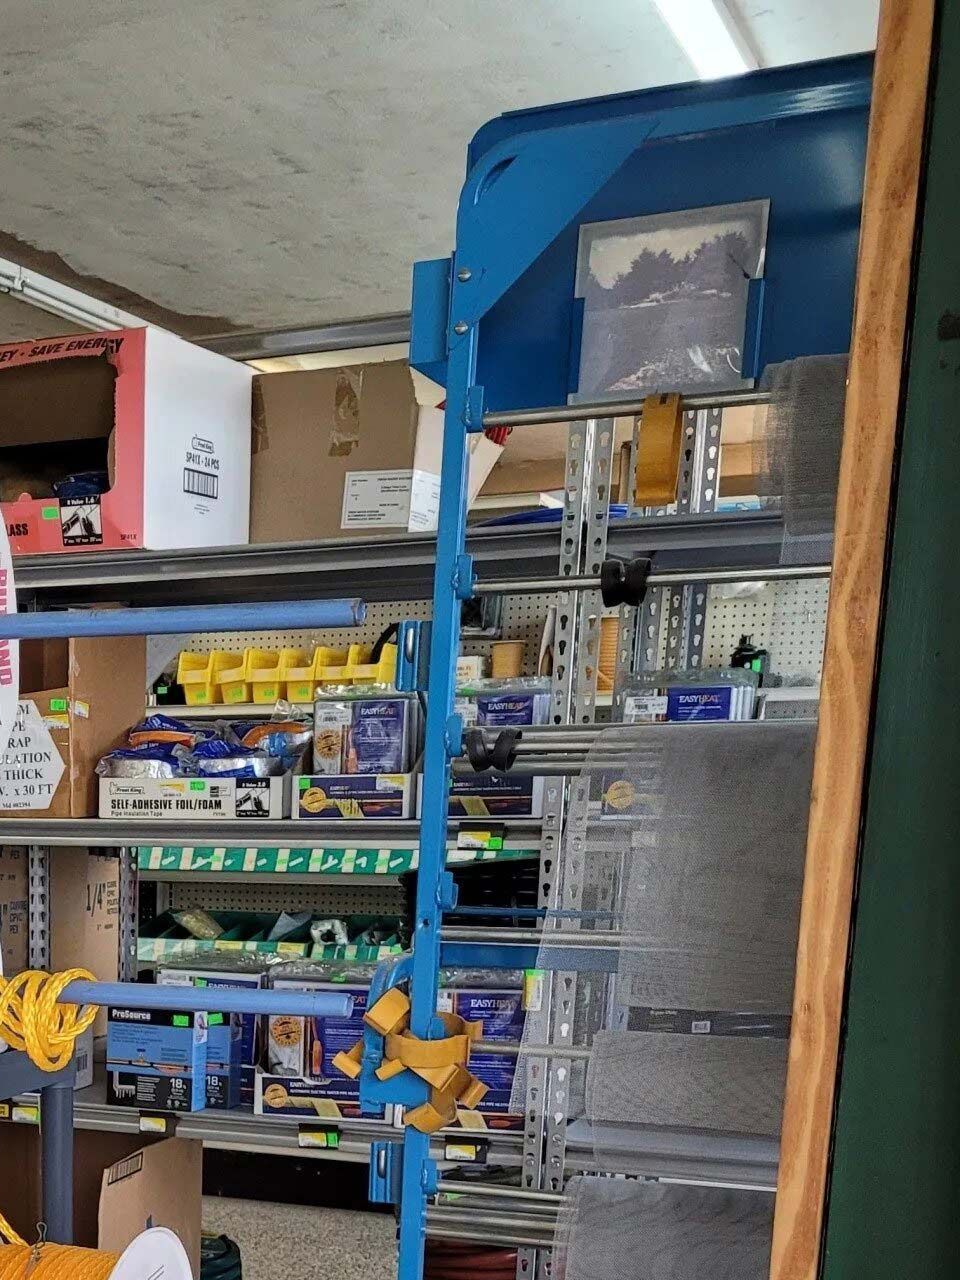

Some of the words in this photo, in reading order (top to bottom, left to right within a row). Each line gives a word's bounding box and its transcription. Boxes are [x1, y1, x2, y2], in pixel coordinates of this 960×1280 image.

[28, 342, 65, 357] SAVE
[678, 694, 719, 704] EASYHEAT
[4, 768, 44, 781] THICK
[23, 785, 35, 796] 30
[38, 783, 54, 795] FT
[111, 799, 173, 810] SELF-ADHESIVE
[175, 799, 222, 811] FOIL/FOAM
[112, 1009, 151, 1020] ProSource
